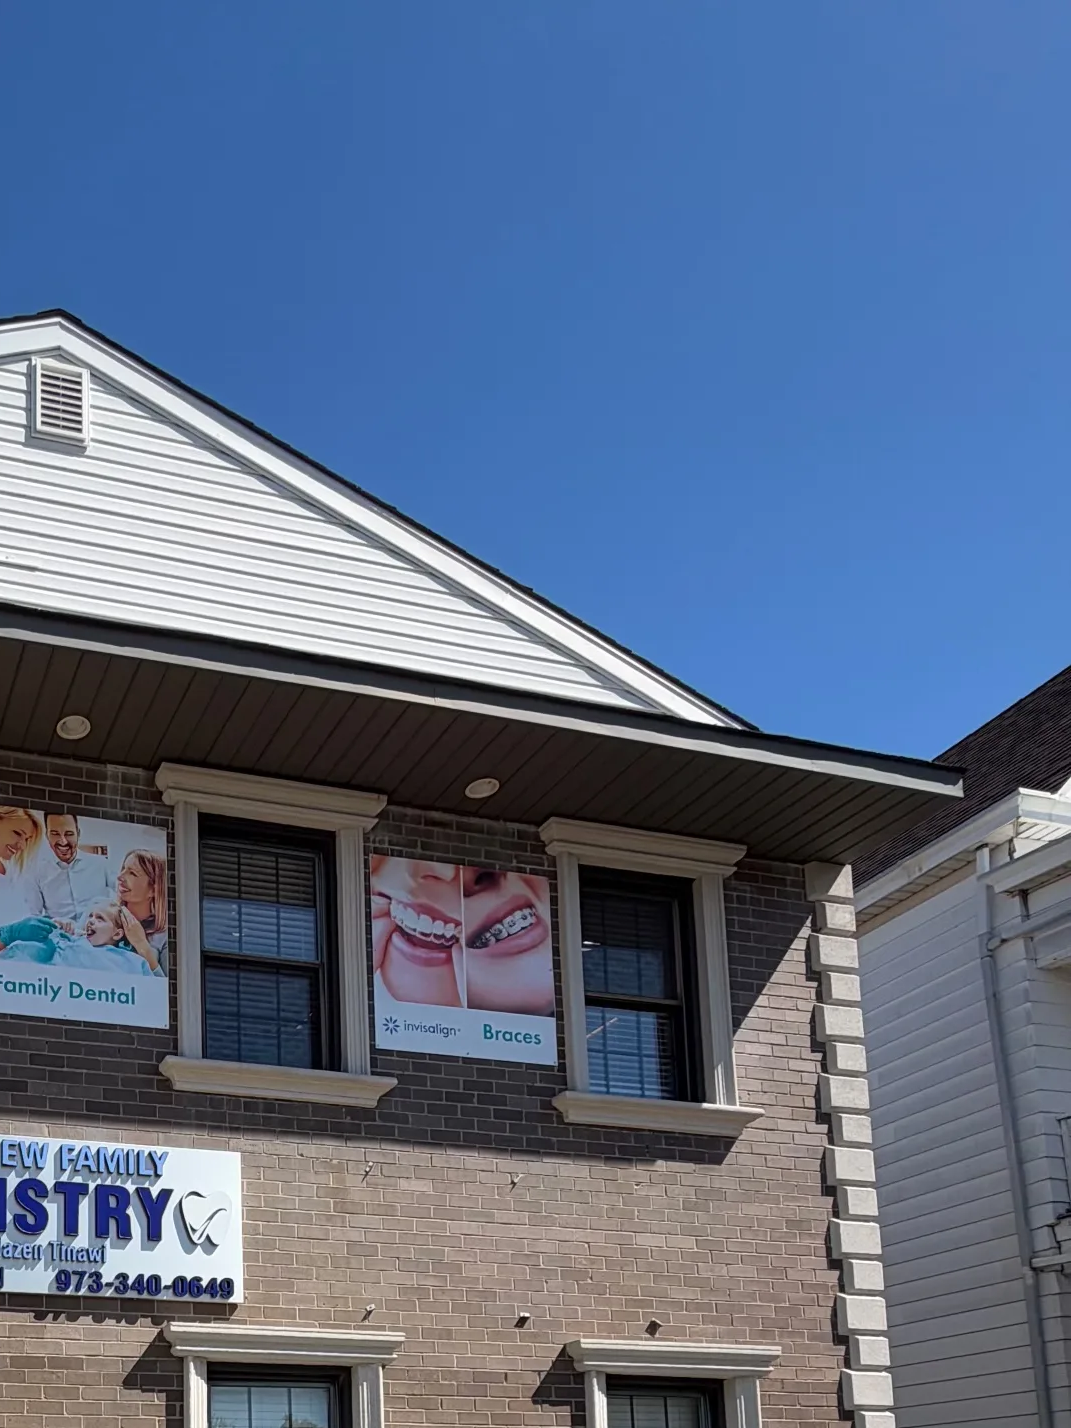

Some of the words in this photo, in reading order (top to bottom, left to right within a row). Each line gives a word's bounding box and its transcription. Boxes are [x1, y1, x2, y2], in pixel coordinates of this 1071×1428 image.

[69, 981, 136, 1005] Dental
[403, 1020, 457, 1039] invisalign
[483, 1023, 542, 1045] Braces
[60, 1143, 170, 1178] FAMILY
[54, 1269, 235, 1299] 973-340-0649
